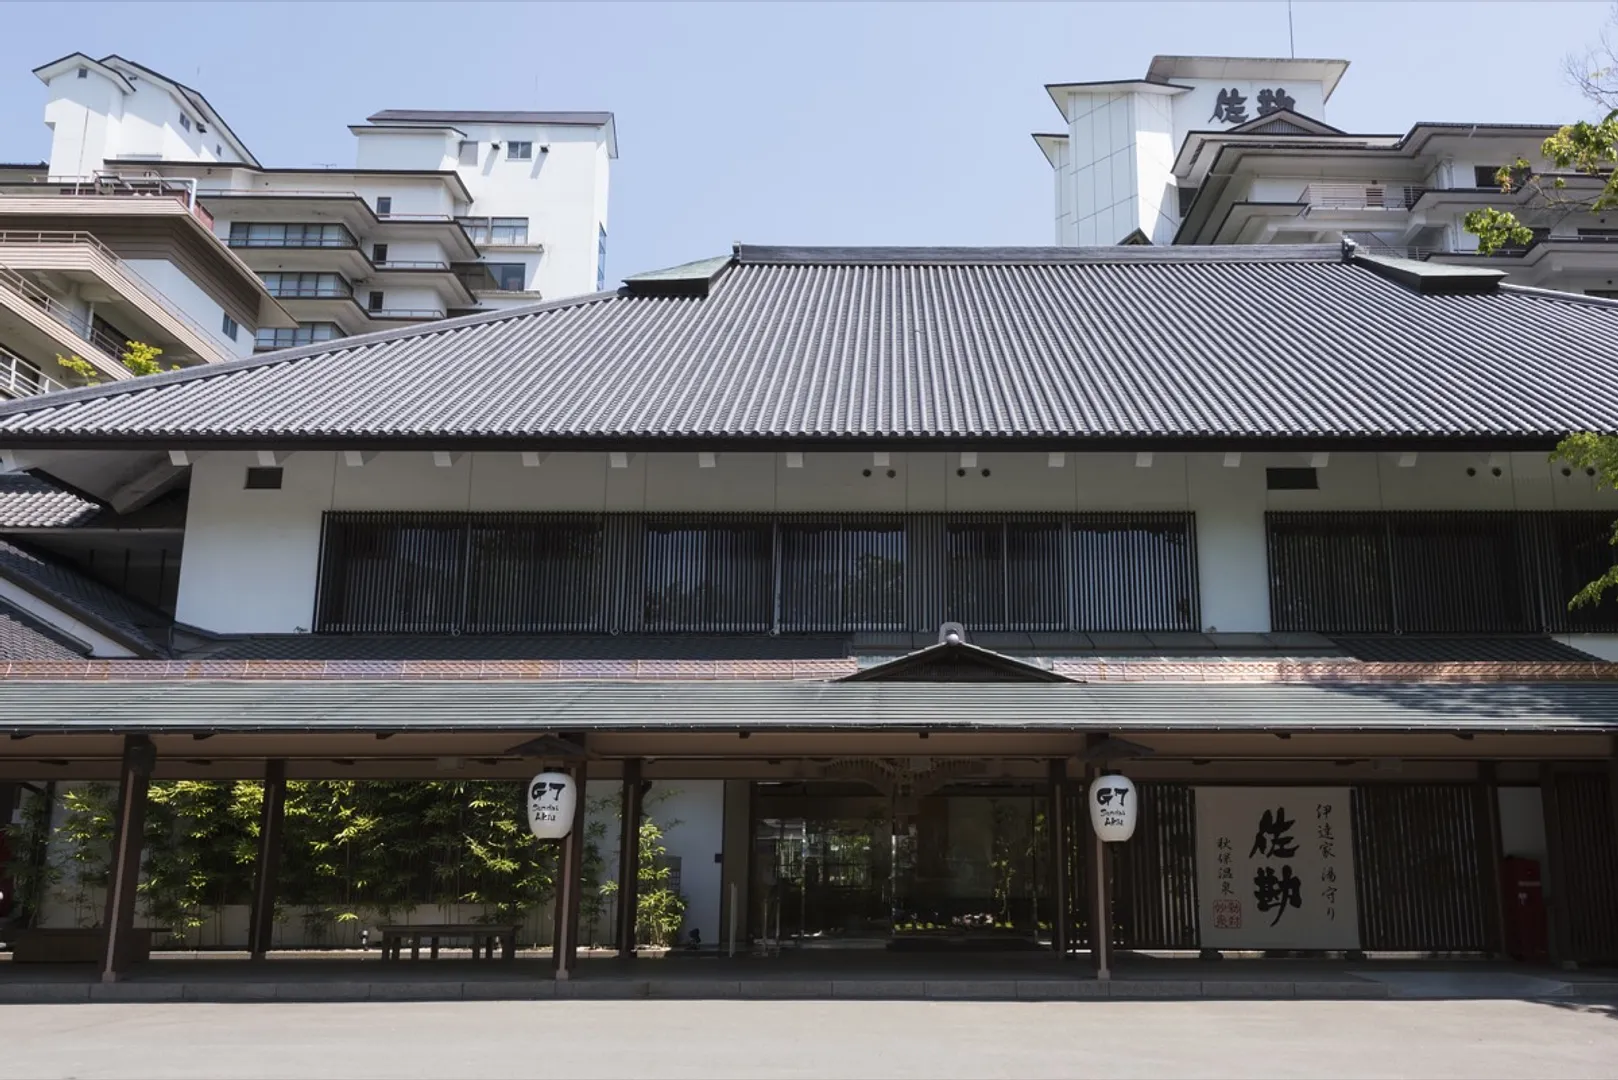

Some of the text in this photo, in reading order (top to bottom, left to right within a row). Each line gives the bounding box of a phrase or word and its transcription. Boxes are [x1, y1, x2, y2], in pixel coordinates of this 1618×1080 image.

[531, 782, 566, 801] G7
[1096, 787, 1129, 807] G7
[1217, 836, 1235, 896] 秋保温泉
[1249, 806, 1303, 928] 佐勘
